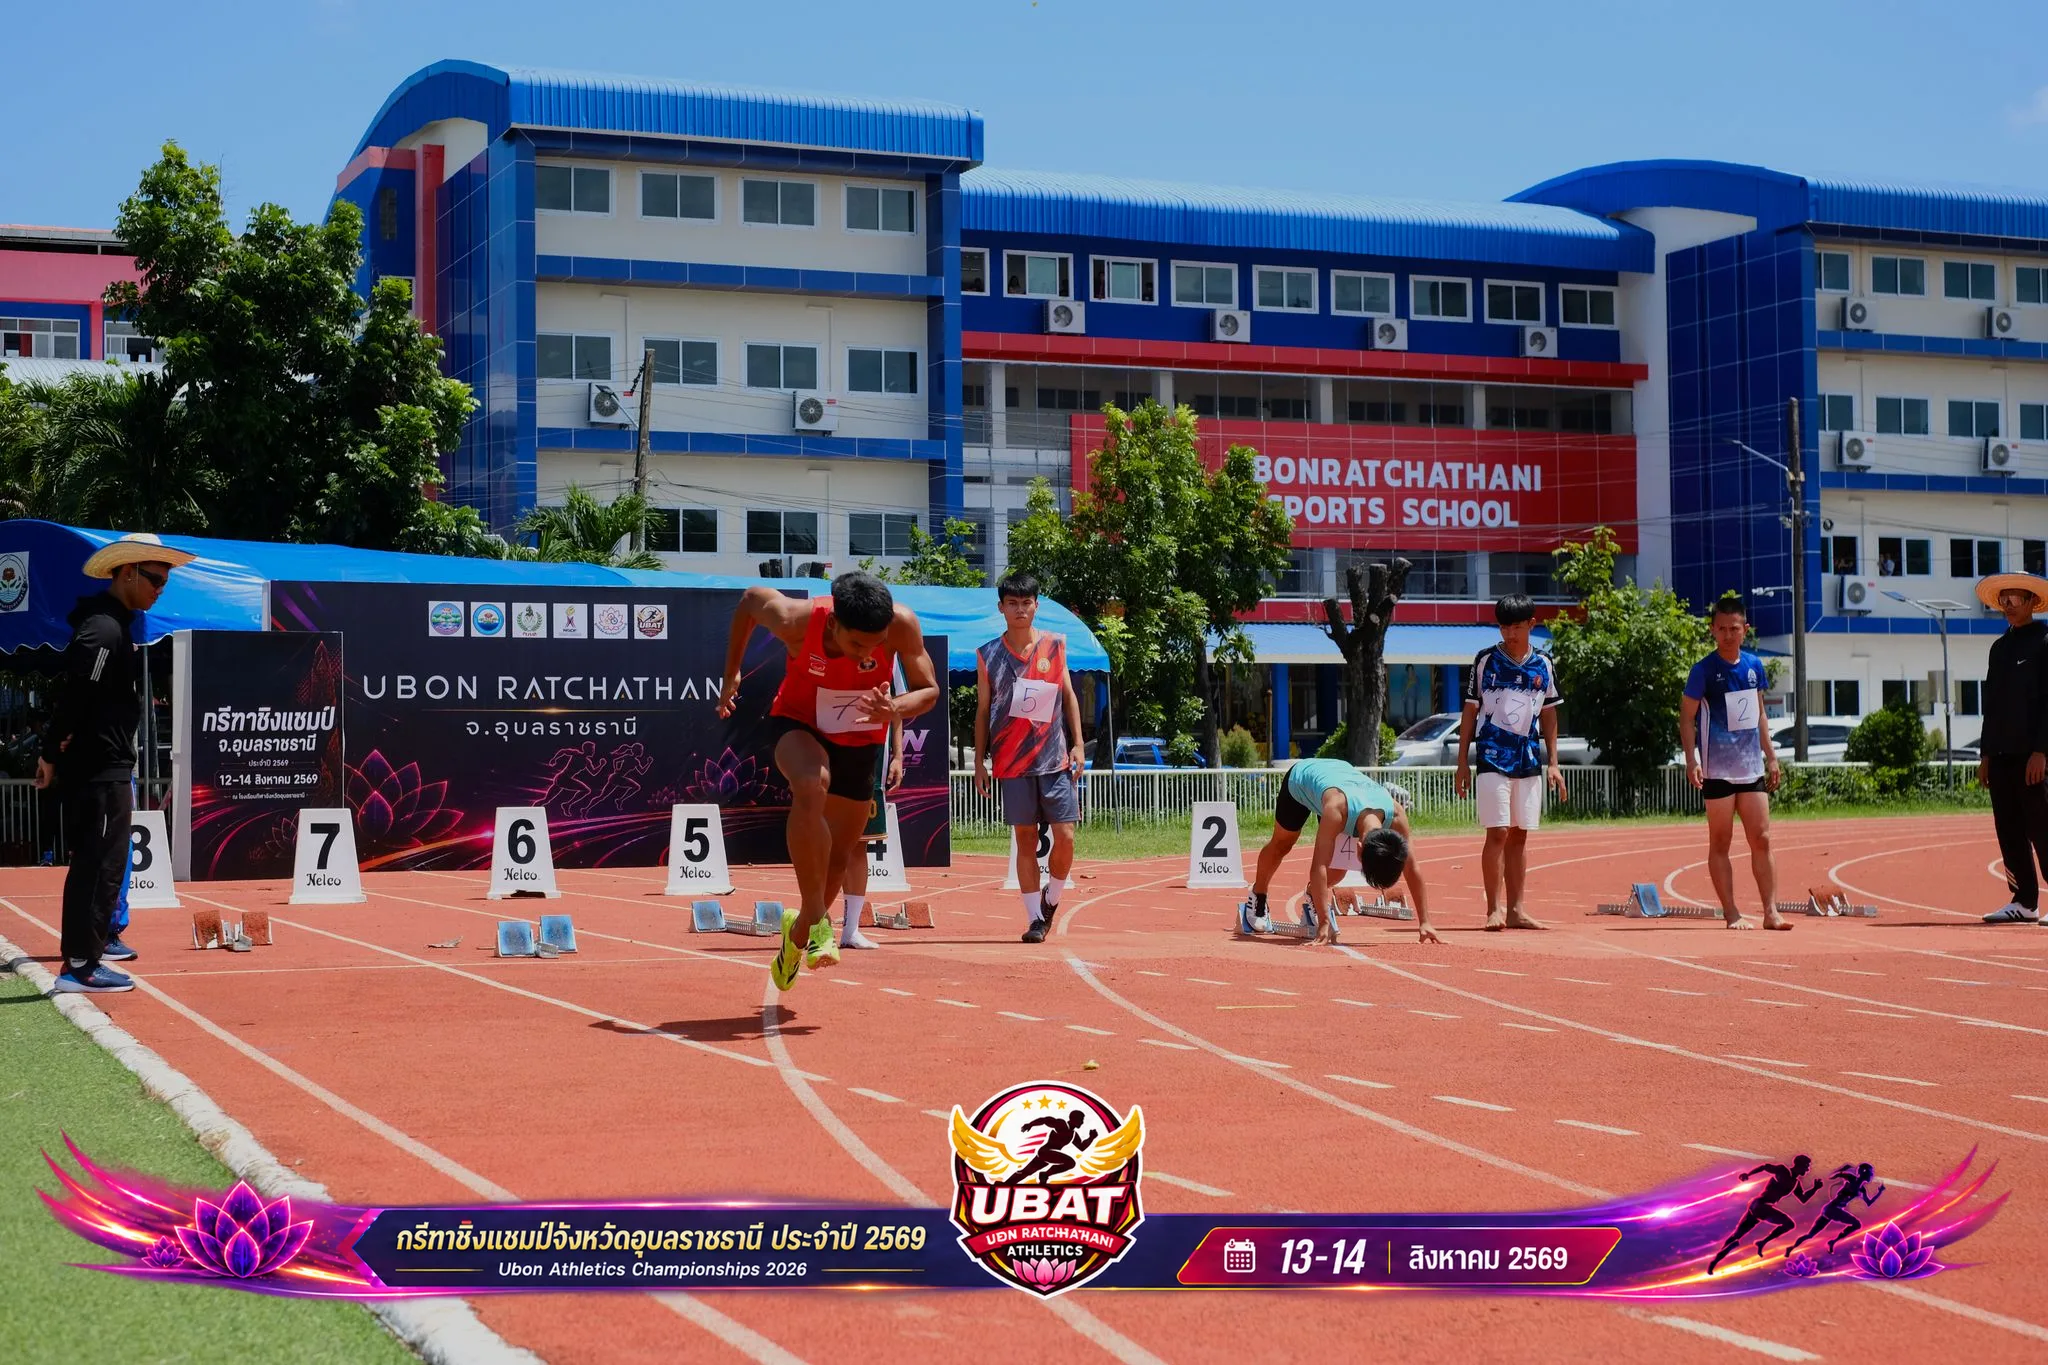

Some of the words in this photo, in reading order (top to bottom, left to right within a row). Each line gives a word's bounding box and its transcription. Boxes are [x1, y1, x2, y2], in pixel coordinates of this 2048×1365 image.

[1253, 455, 1541, 492] BONRATCHATHANI
[1267, 494, 1386, 525] PORTS
[1402, 498, 1519, 528] SCHOOL
[363, 675, 477, 700] UBON
[498, 675, 723, 700] RATCHATHAN
[1020, 687, 1040, 713] 5
[202, 705, 336, 732] กรีฑาชิงแชมป์
[832, 695, 860, 720] 7
[1501, 698, 1526, 726] 3
[1737, 697, 1751, 722] 2
[466, 716, 637, 742] จ.อุบลราชธานี
[218, 733, 317, 757] จ.อุบลราชธานี
[248, 758, 271, 767] ประจำปี
[272, 759, 289, 767] 2569
[219, 774, 252, 786] 12-14
[254, 773, 291, 785] สิงหาคม
[294, 773, 318, 785] 2569
[131, 824, 153, 873] 8
[310, 822, 341, 870] 7
[507, 818, 537, 865] 6
[683, 817, 710, 863] 5
[1201, 815, 1228, 858] 2
[1340, 835, 1355, 860] 4
[306, 873, 342, 887] Nelco
[504, 867, 538, 881] Nelco
[680, 865, 712, 879] Nelco
[867, 864, 889, 877] elco
[1199, 861, 1230, 875] Nelco
[128, 876, 155, 889] elco
